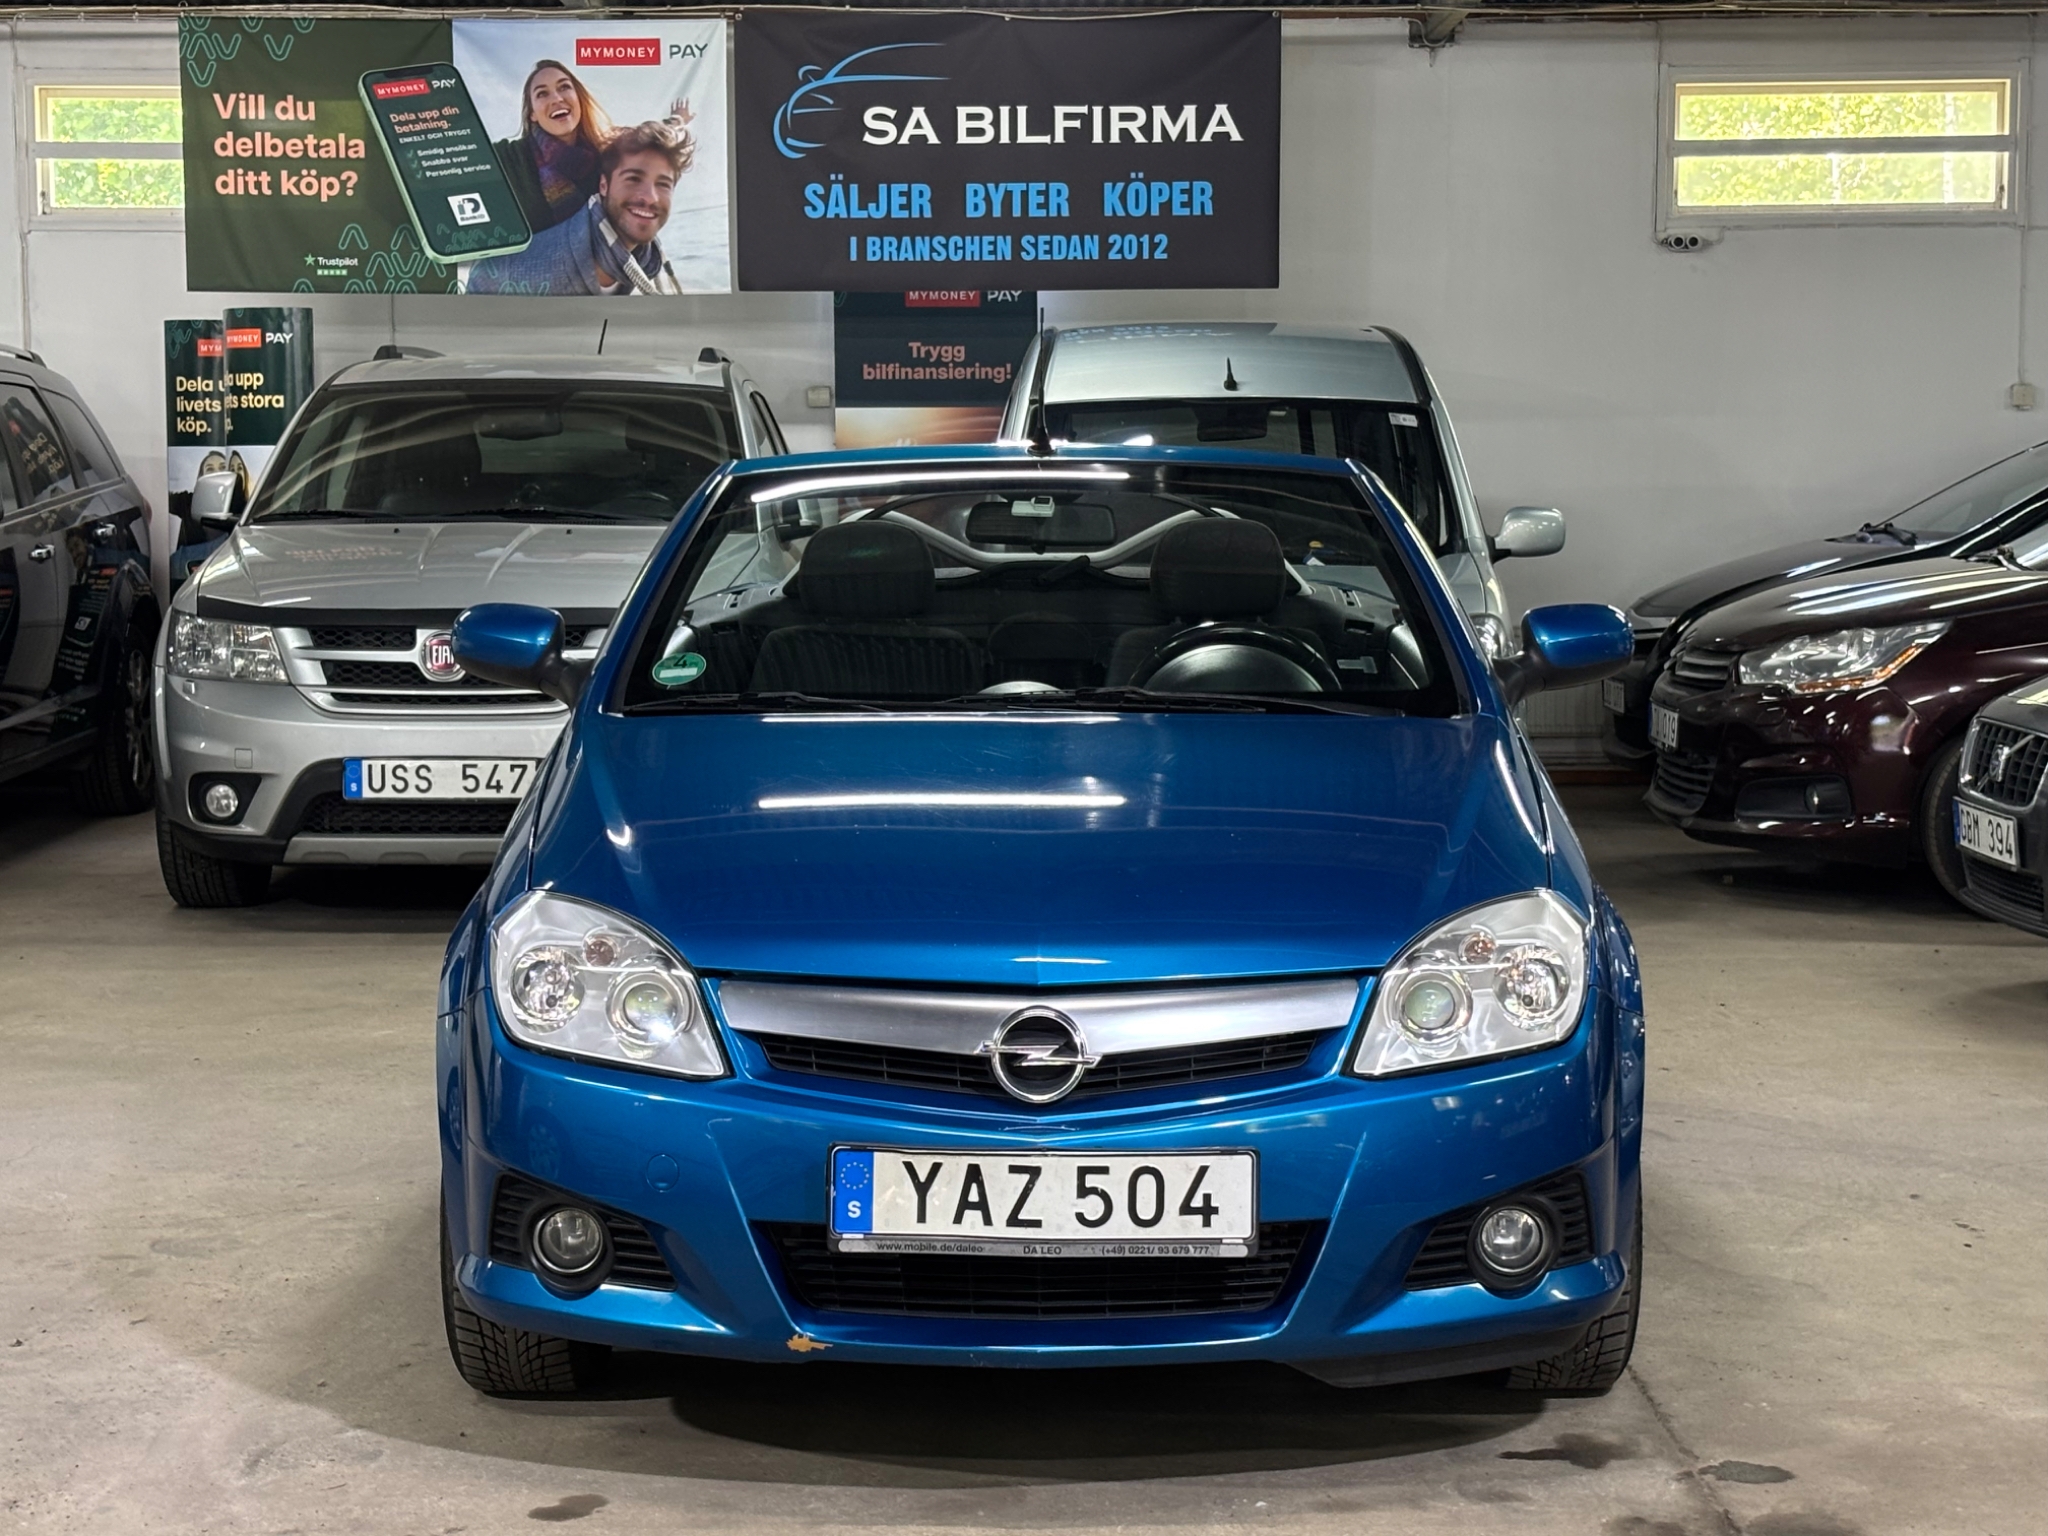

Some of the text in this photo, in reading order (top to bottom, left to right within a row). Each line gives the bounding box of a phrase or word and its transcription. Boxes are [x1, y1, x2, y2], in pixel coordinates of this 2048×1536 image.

[580, 43, 708, 59] MYMONEY PAY
[377, 78, 456, 96] MYMONEY PAY
[212, 92, 316, 121] Vill du
[389, 105, 460, 123] Dela upp din
[394, 119, 452, 134] betalning.
[862, 104, 1244, 145] SA BILFIRMA
[213, 131, 366, 159] delbetala
[214, 168, 359, 203] ditt köp?
[803, 172, 1214, 219] SÄLJER BYTER KÖPER
[849, 234, 1169, 262] I BRANSCHEN SEDAN 2012
[317, 256, 359, 268] Trustpilot
[909, 290, 1022, 302] MYMONEY PAY
[265, 332, 293, 344] PAY
[908, 342, 966, 362] Trygg
[235, 372, 264, 390] upp
[862, 362, 1012, 384] bilfinansiering!
[176, 375, 214, 392] Dela
[176, 395, 222, 413] livets
[241, 391, 285, 409] stora
[177, 416, 212, 436] köp.
[367, 763, 529, 794] USS 547
[1987, 818, 2013, 859] 394
[902, 1160, 1220, 1229] YAZ 504
[846, 1200, 862, 1219] S
[876, 1241, 984, 1254] www.mobile.de/daleo
[1041, 1246, 1063, 1256] LEO
[1157, 1246, 1170, 1256] 93
